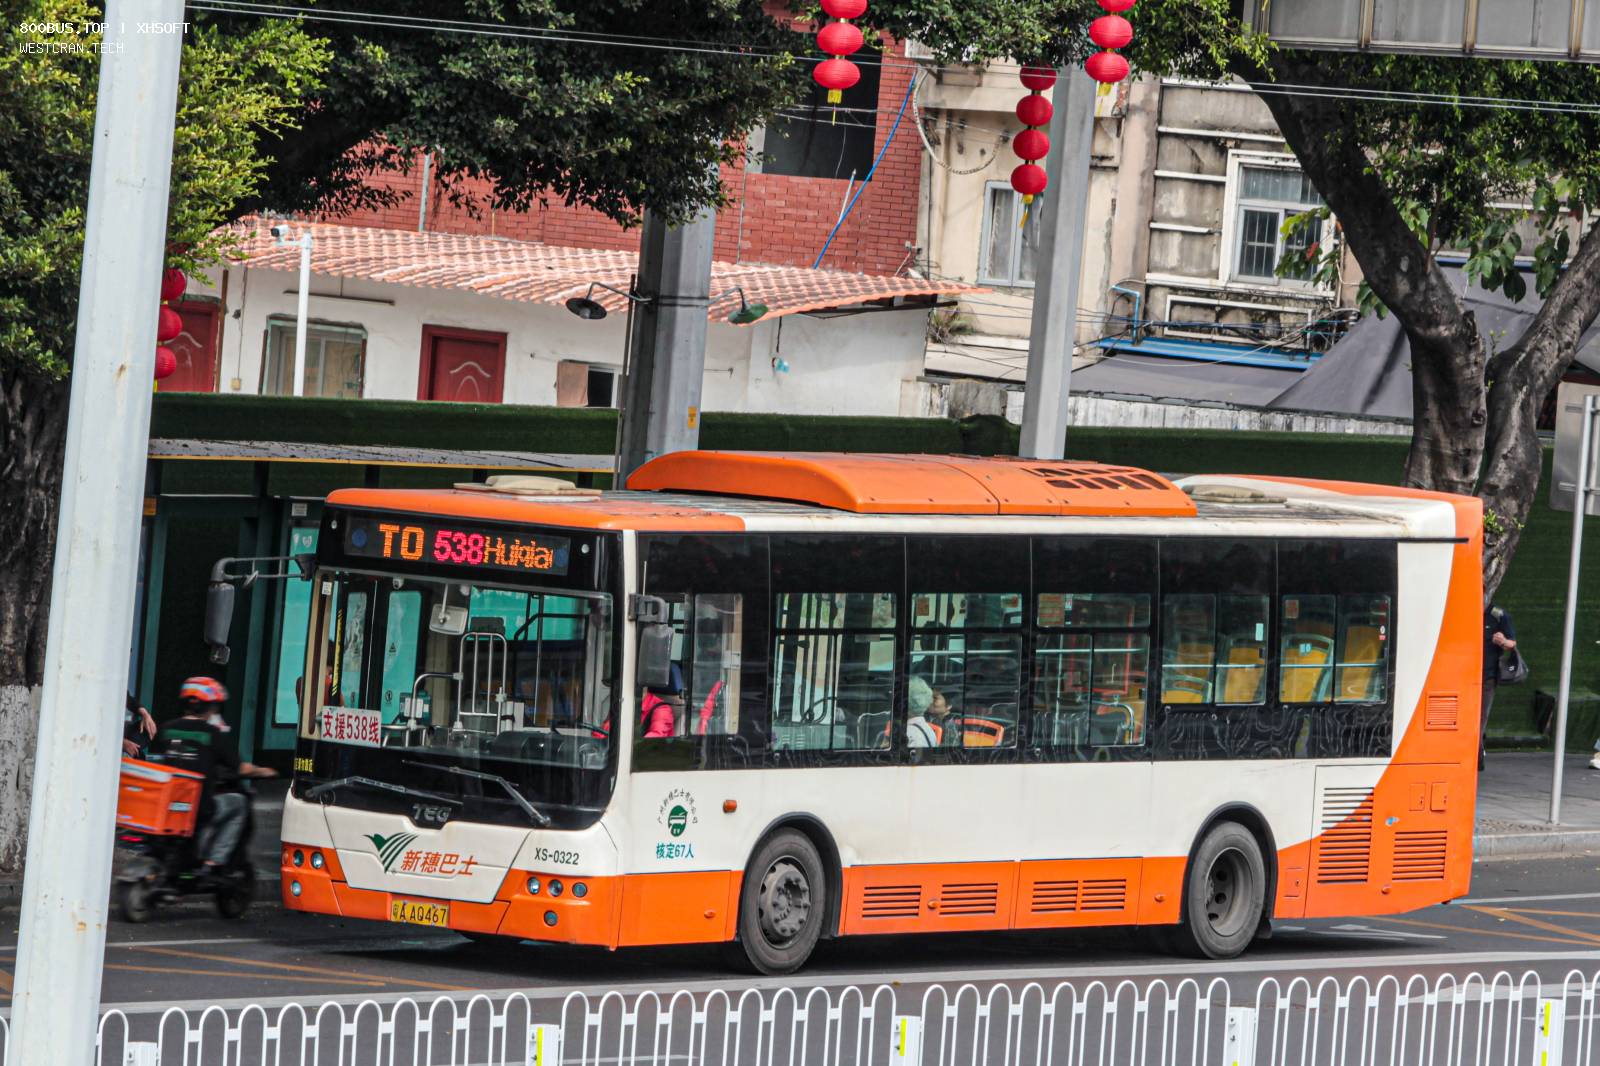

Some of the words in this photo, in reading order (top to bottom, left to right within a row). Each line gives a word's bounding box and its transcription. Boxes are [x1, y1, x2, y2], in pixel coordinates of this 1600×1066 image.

[379, 523, 424, 560] TO
[484, 536, 553, 569] Huiqia
[323, 711, 379, 744] 支援538线
[400, 850, 478, 875] 新穗巴士
[534, 847, 580, 866] XS-0322
[656, 843, 694, 859] 核定67人
